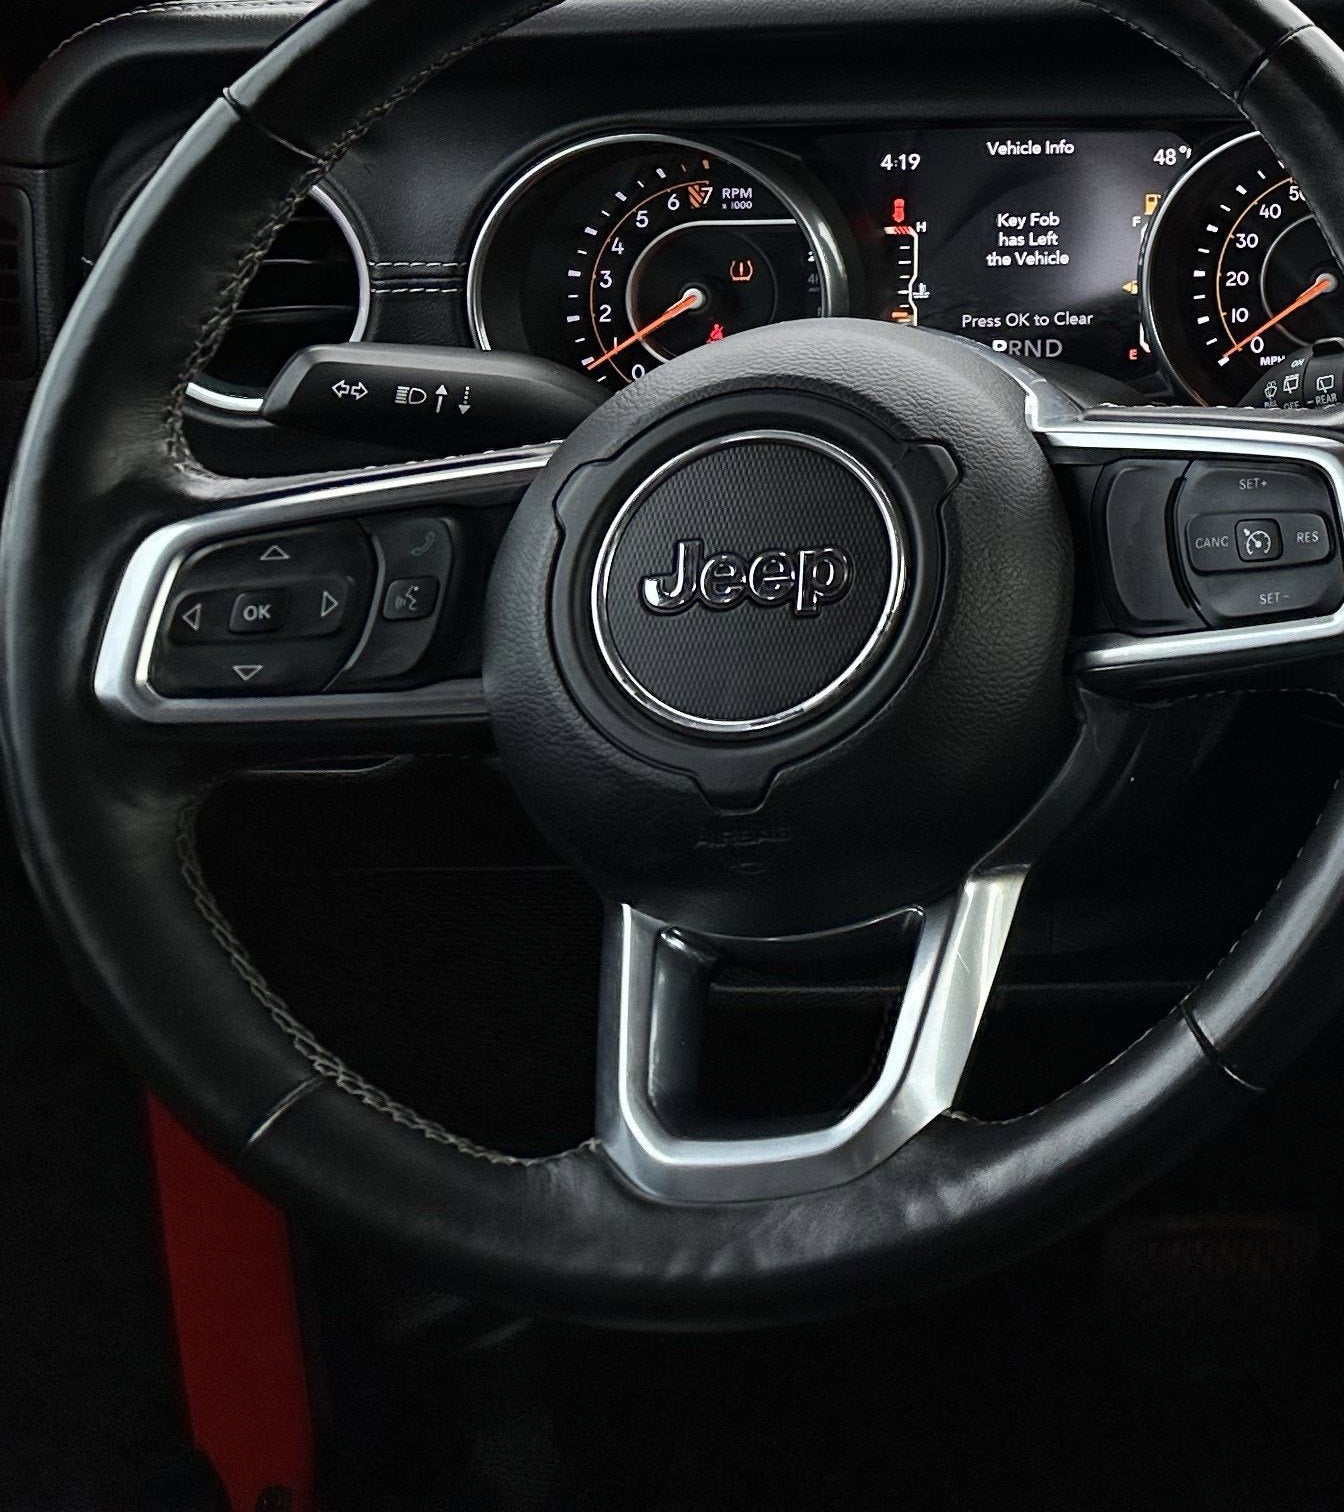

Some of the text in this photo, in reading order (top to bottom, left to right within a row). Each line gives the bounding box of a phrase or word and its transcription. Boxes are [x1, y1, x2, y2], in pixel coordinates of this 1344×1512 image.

[986, 140, 1075, 156] Vehicle Info
[880, 153, 921, 171] 4:19
[700, 187, 714, 205] 7
[722, 188, 753, 199] RPM
[667, 193, 680, 211] 6
[731, 201, 753, 210] 1000
[635, 210, 649, 228] 5
[1259, 203, 1282, 219] 40
[916, 222, 927, 233] H
[997, 212, 1060, 231] Key Fob
[1132, 216, 1141, 228] F
[611, 237, 625, 255] 4
[998, 231, 1059, 247] has Left
[1235, 232, 1259, 249] 30
[986, 251, 1070, 267] the Vehicle
[599, 270, 612, 288] 3
[1225, 270, 1249, 286] 20
[599, 304, 612, 323] 2
[961, 312, 1093, 328] Press OK to Clear
[1231, 307, 1249, 323] 10
[1250, 337, 1265, 354] 0
[1129, 349, 1138, 360] E
[1291, 358, 1305, 368] ON
[631, 364, 646, 381] 0
[1315, 392, 1338, 405] REAR
[1195, 536, 1229, 550] CANC
[1296, 531, 1319, 544] RES
[641, 540, 852, 614] Jeep
[243, 604, 272, 621] OK
